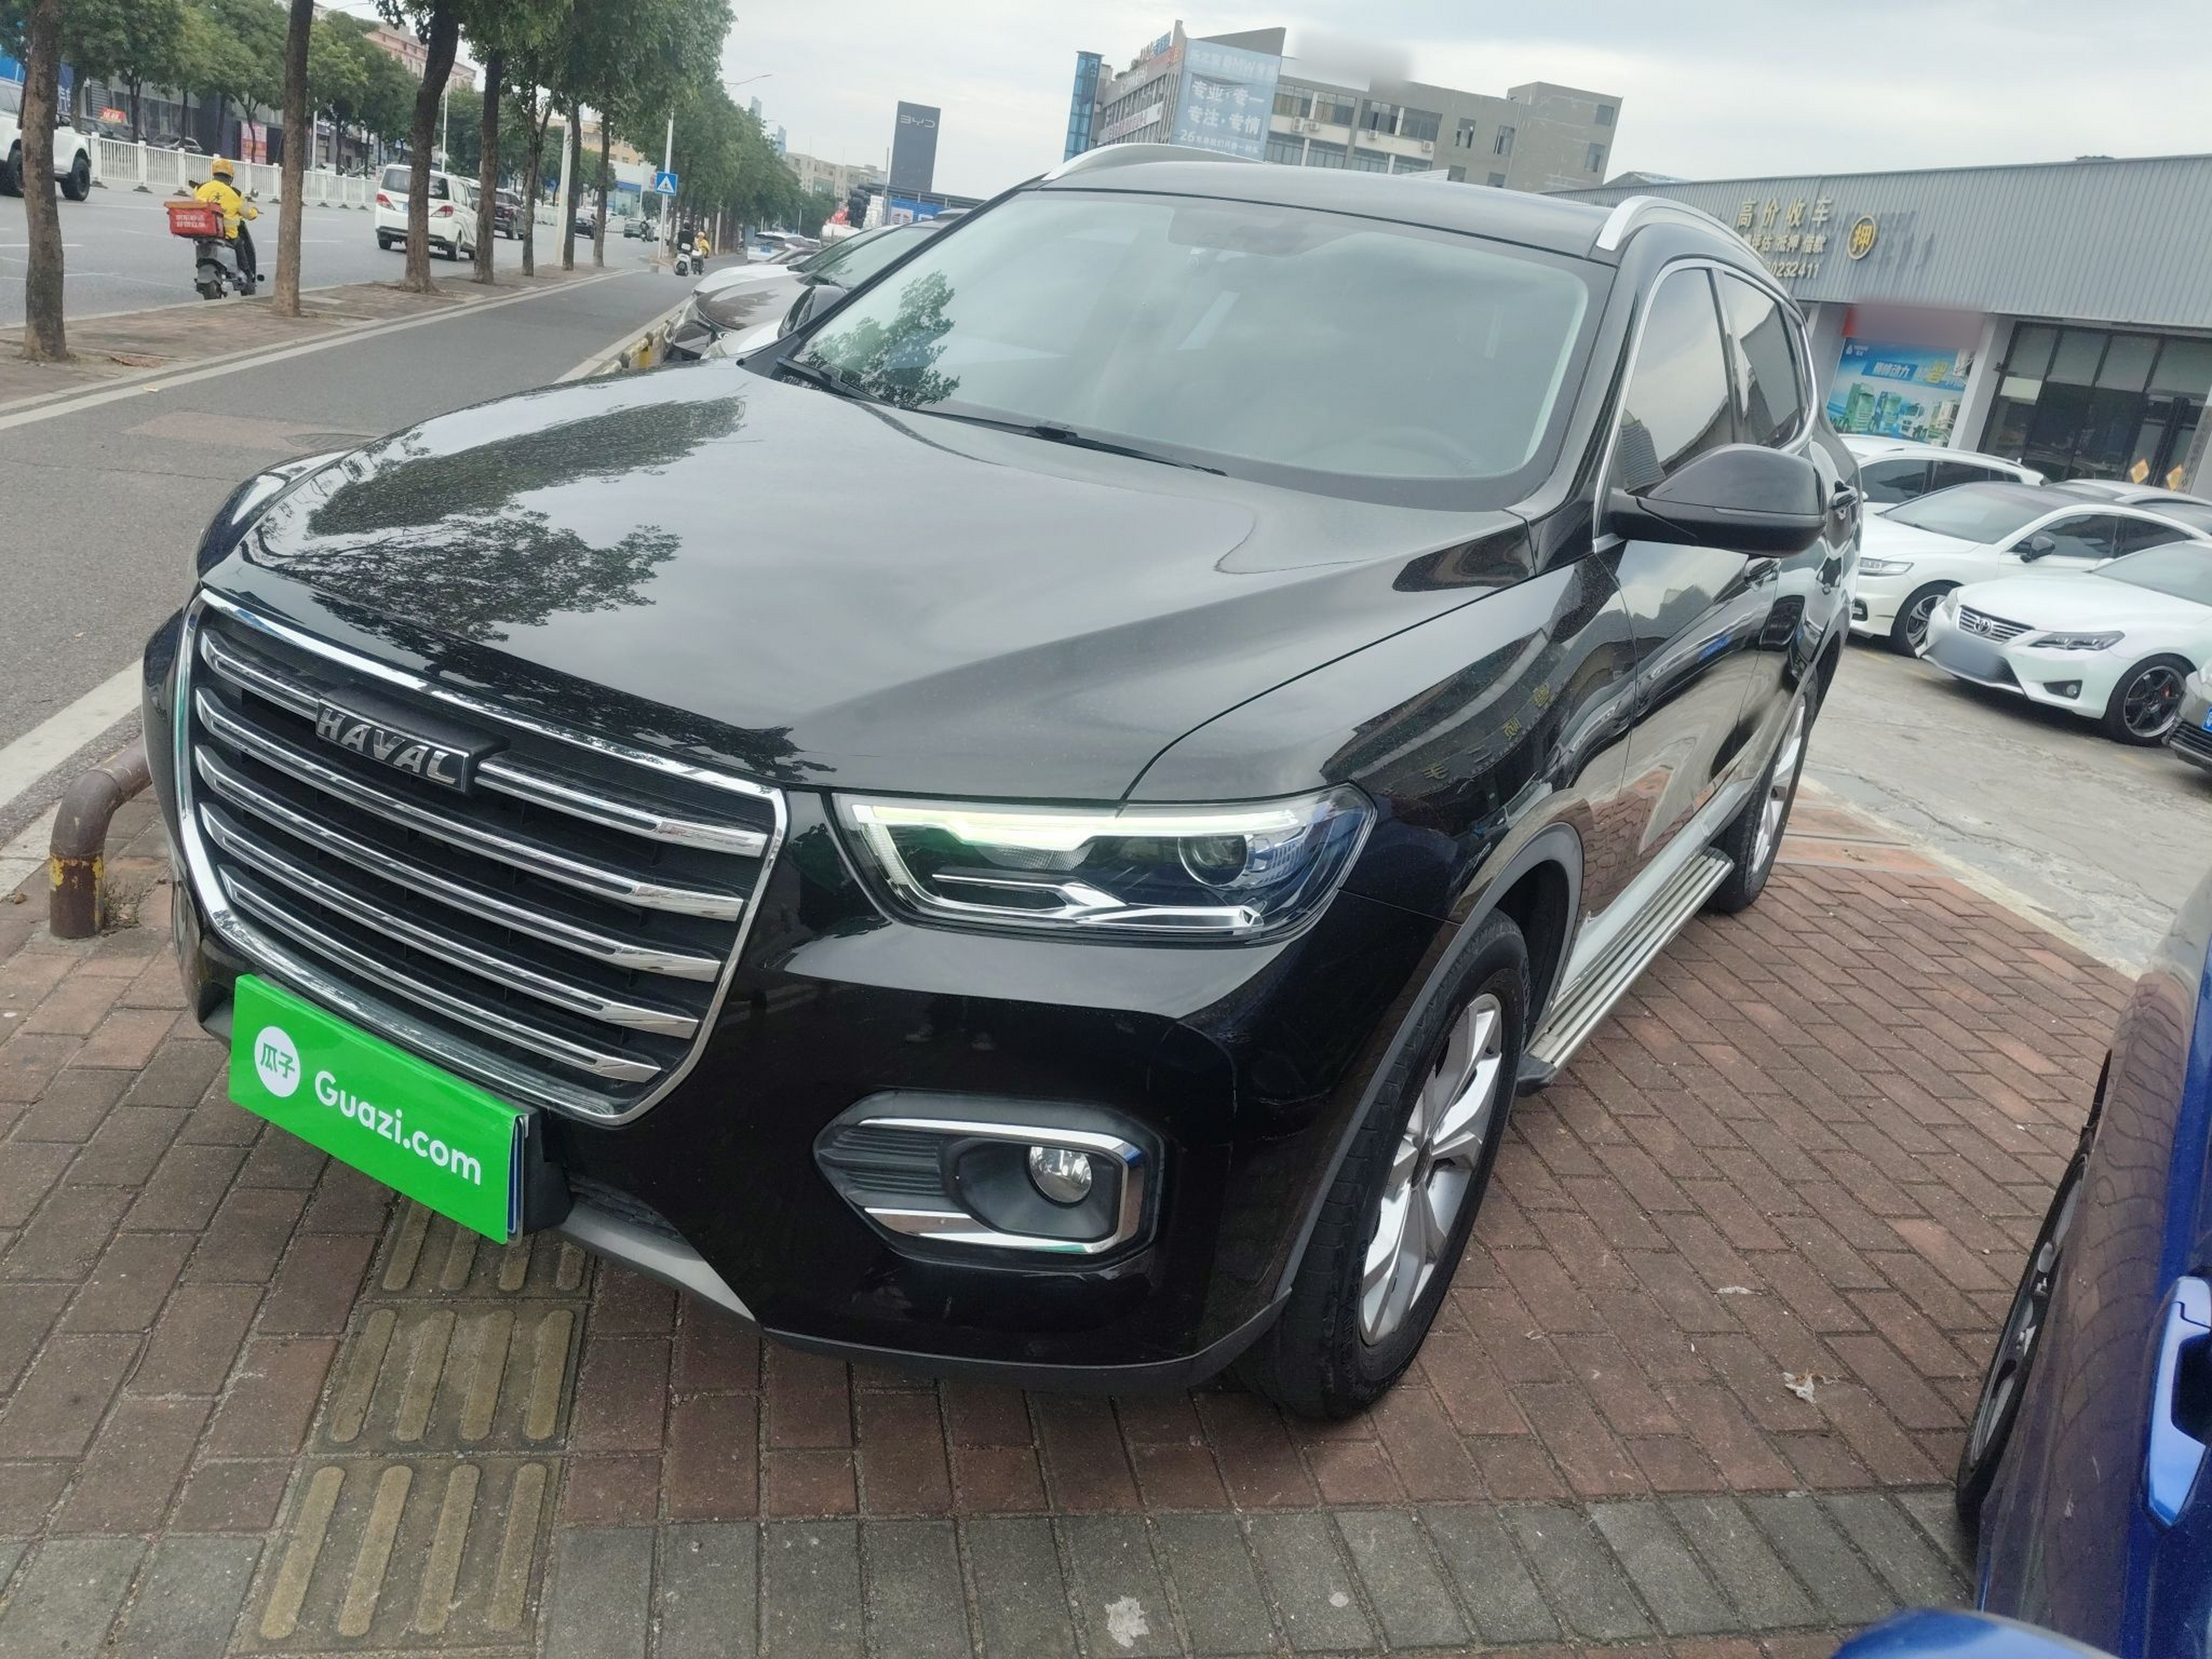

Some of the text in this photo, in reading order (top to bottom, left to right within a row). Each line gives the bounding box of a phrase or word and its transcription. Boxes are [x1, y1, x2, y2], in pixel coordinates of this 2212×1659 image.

[900, 115, 935, 128] BYD
[1738, 198, 1832, 228] 高价收车
[1776, 233, 1800, 252] 抵押
[1803, 233, 1827, 253] 借款
[1851, 224, 1873, 252] 押
[1767, 262, 1819, 278] 0232411
[318, 708, 456, 785] HAVAL
[260, 1041, 296, 1080] 瓜子
[315, 1070, 482, 1186] Guazi.com
